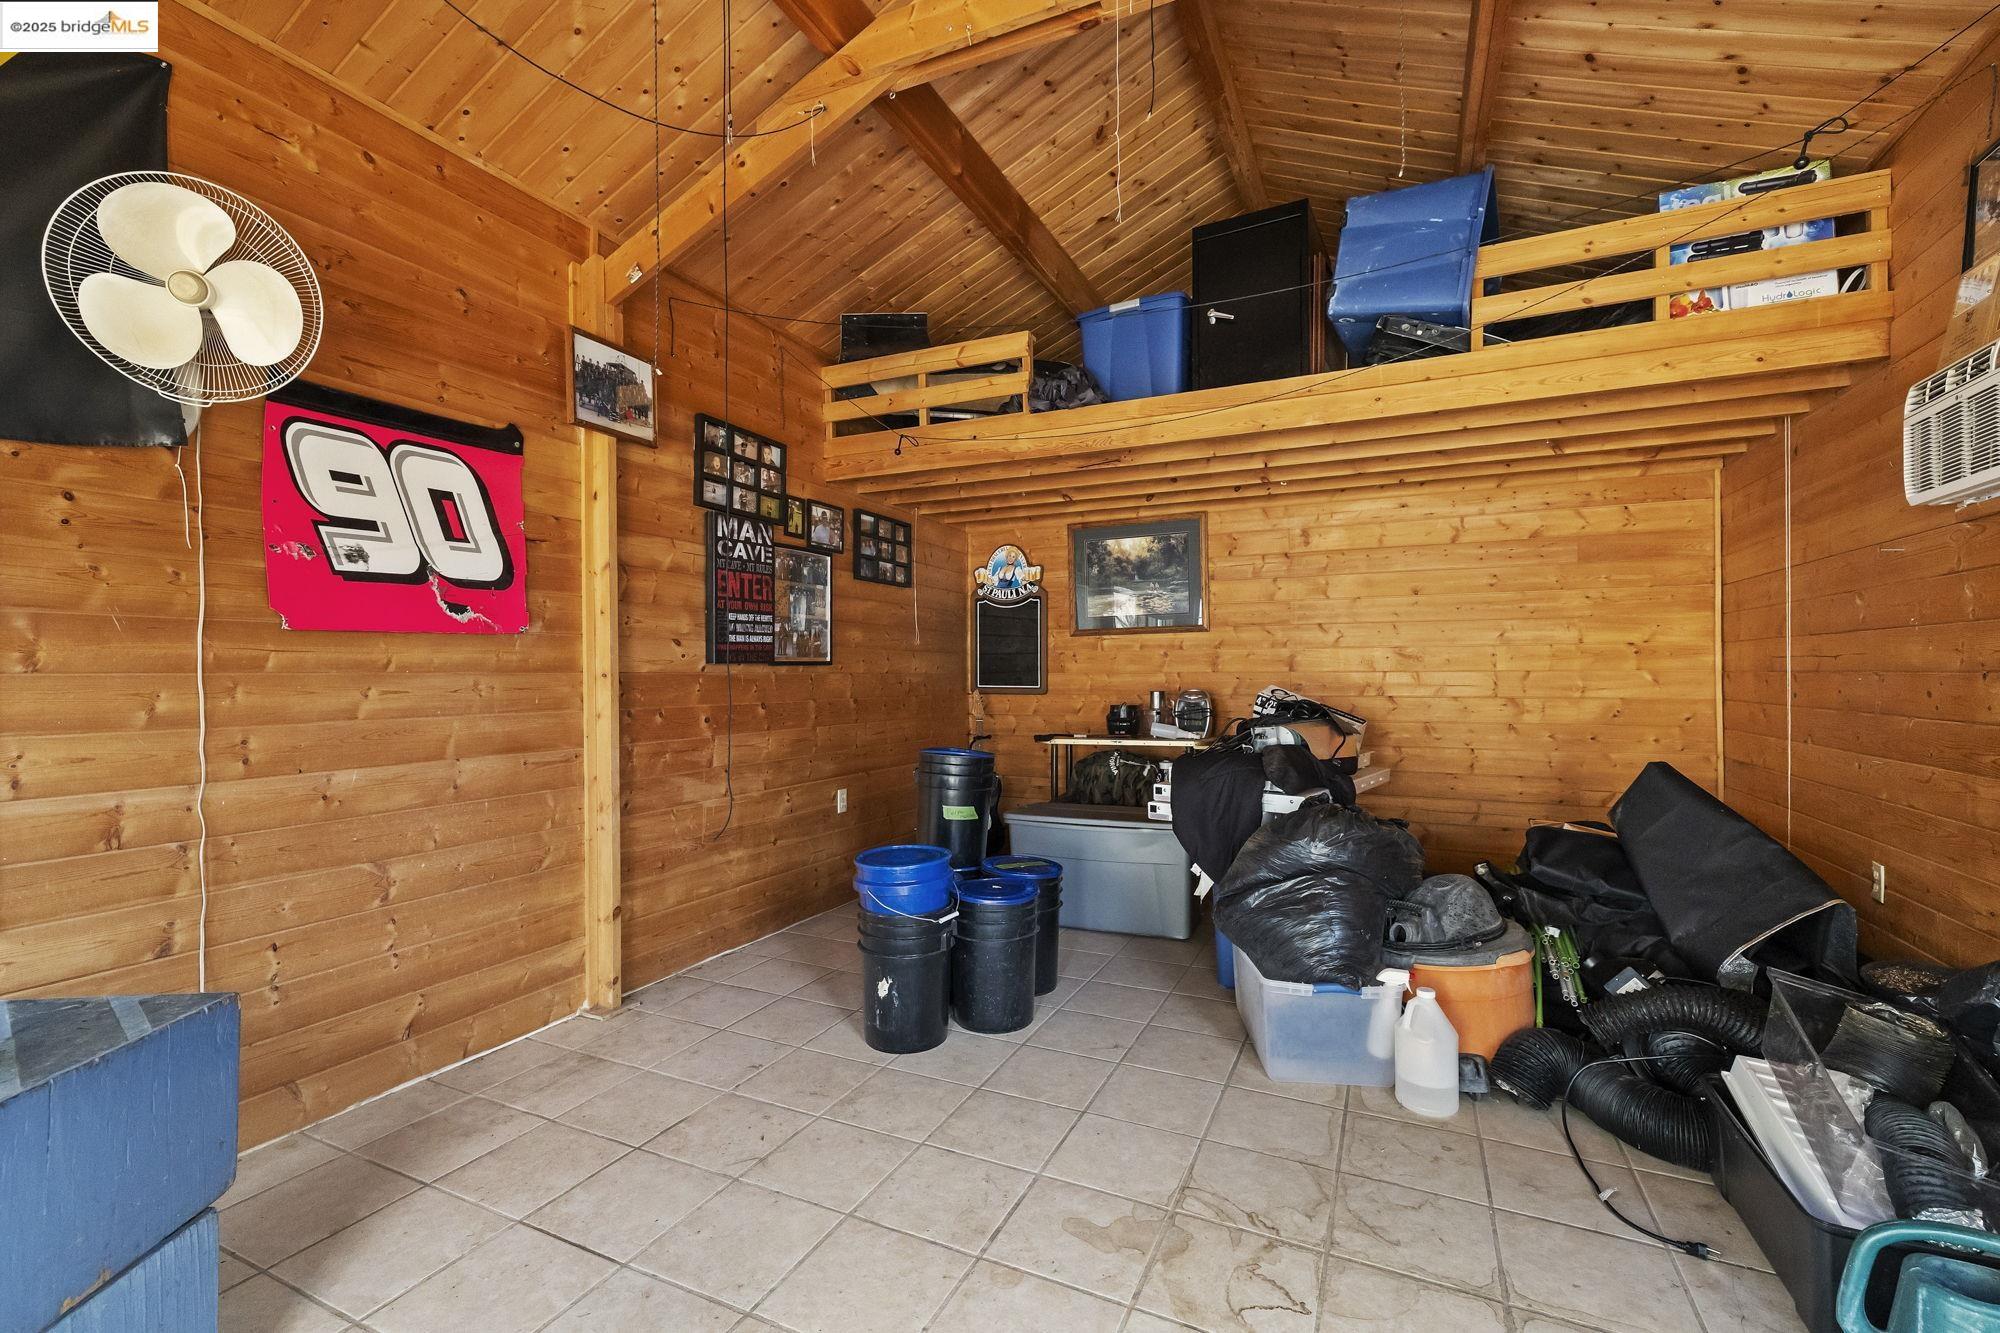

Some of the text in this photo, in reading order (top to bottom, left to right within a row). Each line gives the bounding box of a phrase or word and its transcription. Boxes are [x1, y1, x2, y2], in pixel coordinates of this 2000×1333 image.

[281, 416, 514, 590] 90
[717, 514, 772, 546] MAN
[717, 540, 773, 564] CAVE
[717, 568, 773, 602] ENTER
[991, 588, 1017, 599] PAULI
[717, 600, 725, 609] AT
[727, 600, 743, 610] YOUR
[744, 601, 759, 611] OWN
